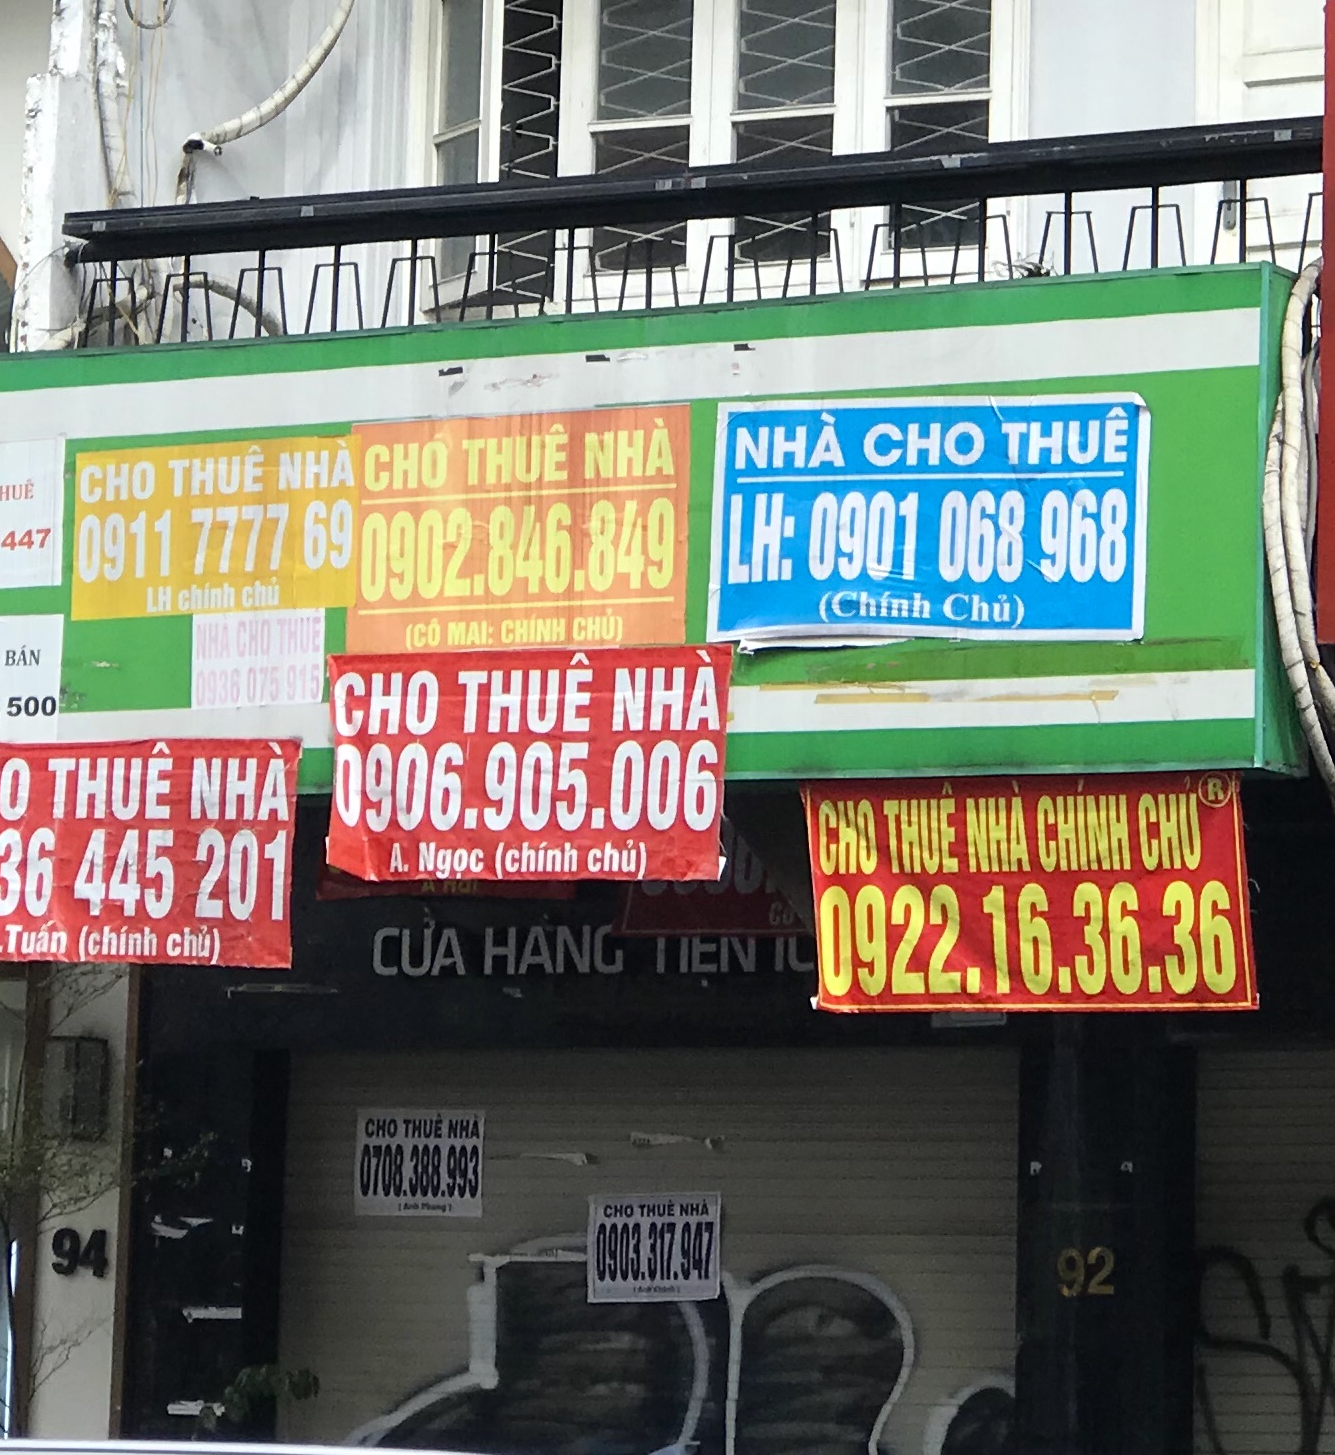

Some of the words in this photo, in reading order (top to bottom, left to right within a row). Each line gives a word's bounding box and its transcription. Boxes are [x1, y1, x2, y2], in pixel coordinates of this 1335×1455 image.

[364, 438, 448, 492] CHO
[462, 423, 569, 486] THUÊ
[584, 418, 674, 480] NHÀ
[734, 411, 846, 470] NHÀ
[864, 422, 985, 467] CHO
[1002, 407, 1129, 465] THUÊ
[80, 461, 155, 503] CHO
[168, 445, 264, 497] THUÊ
[278, 439, 355, 490] NHÀ
[1, 528, 52, 551] 447
[78, 509, 172, 583] 0911
[191, 503, 289, 575] 7777
[303, 498, 353, 570] 69
[360, 497, 674, 602] 0902.846.849
[727, 492, 795, 584] LH:
[808, 491, 919, 582] 0901
[938, 490, 1025, 583] 068
[1039, 488, 1128, 583] 968
[146, 586, 172, 613] LH
[178, 580, 235, 611] chính
[241, 576, 280, 607] chủ
[819, 590, 931, 623] (Chính
[943, 592, 1025, 628] Chủ)
[236, 619, 271, 658] CHO
[501, 615, 565, 644] CHÍNH
[572, 608, 624, 643] CHỦ)
[5, 645, 41, 667] BÁN
[6, 695, 57, 717] 500
[196, 667, 240, 707] 0936
[246, 665, 280, 703] 075
[286, 663, 320, 701] 915
[334, 671, 439, 737] CHO
[458, 652, 594, 734] THUÊ
[612, 650, 721, 732] NHÀ
[48, 741, 173, 821] THUÊ
[190, 741, 289, 821] NHÀ
[335, 740, 718, 832] 0906.905.006
[819, 799, 878, 875] CHO
[883, 780, 959, 874] THUÊ
[967, 780, 1031, 872] NHÀ
[1037, 779, 1131, 872] CHÍNH
[1138, 776, 1201, 871] CHỦ
[74, 828, 174, 918] 445
[195, 828, 287, 920] 201
[390, 843, 409, 873] A.
[418, 842, 484, 879] Ngọc
[494, 841, 577, 879] (chính
[587, 839, 647, 879] chủ)
[79, 925, 157, 962] (chính
[166, 926, 220, 965] chủ)
[819, 881, 1236, 996] 0922.16.36.36
[365, 1119, 398, 1138] CHO
[403, 1113, 442, 1138] THUÊ
[447, 1114, 481, 1139] NHÀ
[359, 1144, 480, 1198] 0708.388.993
[603, 1204, 634, 1218] CHO
[638, 1199, 675, 1218] THUÊ
[679, 1198, 709, 1217] NHÀ
[50, 1228, 108, 1279] 94
[596, 1221, 714, 1282] 0903.317.947
[1056, 1246, 1115, 1297] 92
